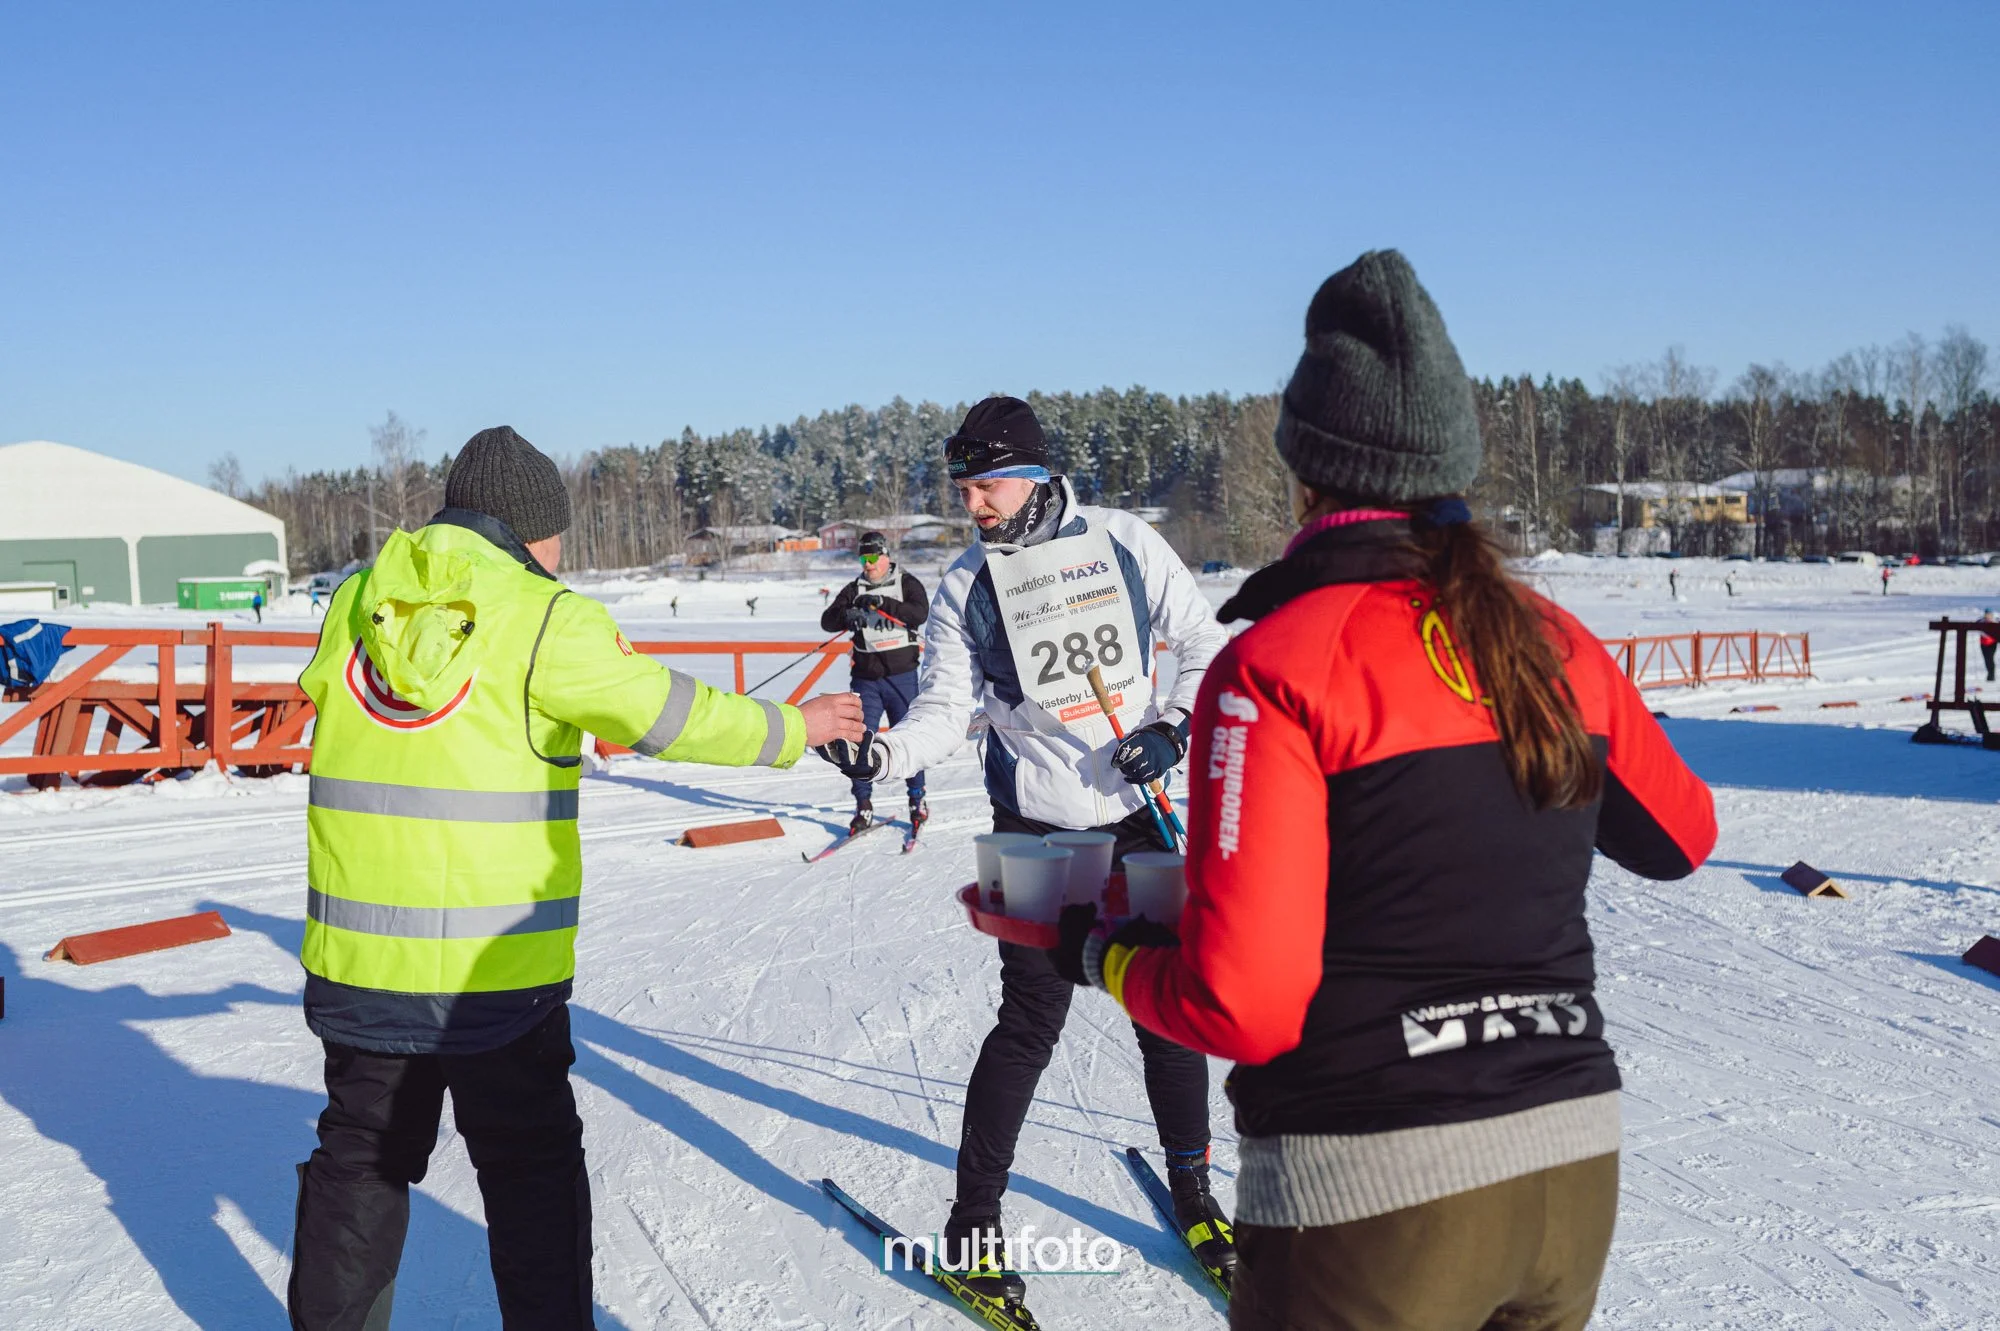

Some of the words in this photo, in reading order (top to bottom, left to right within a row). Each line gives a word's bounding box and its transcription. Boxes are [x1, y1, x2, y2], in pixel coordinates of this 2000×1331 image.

[1005, 574, 1056, 598] multifoto
[1065, 596, 1076, 606] LU
[1077, 585, 1118, 602] RAKENNUS
[1069, 608, 1079, 616] VN
[1080, 596, 1120, 613] BYGGSERVICE
[1016, 620, 1037, 629] BAKERY
[1042, 613, 1065, 622] KITCHEN
[1031, 623, 1123, 686] 288
[1037, 692, 1082, 710] Västerby
[1208, 726, 1228, 779] OSLA
[1409, 1001, 1480, 1023] Water
[1480, 995, 1499, 1012] &
